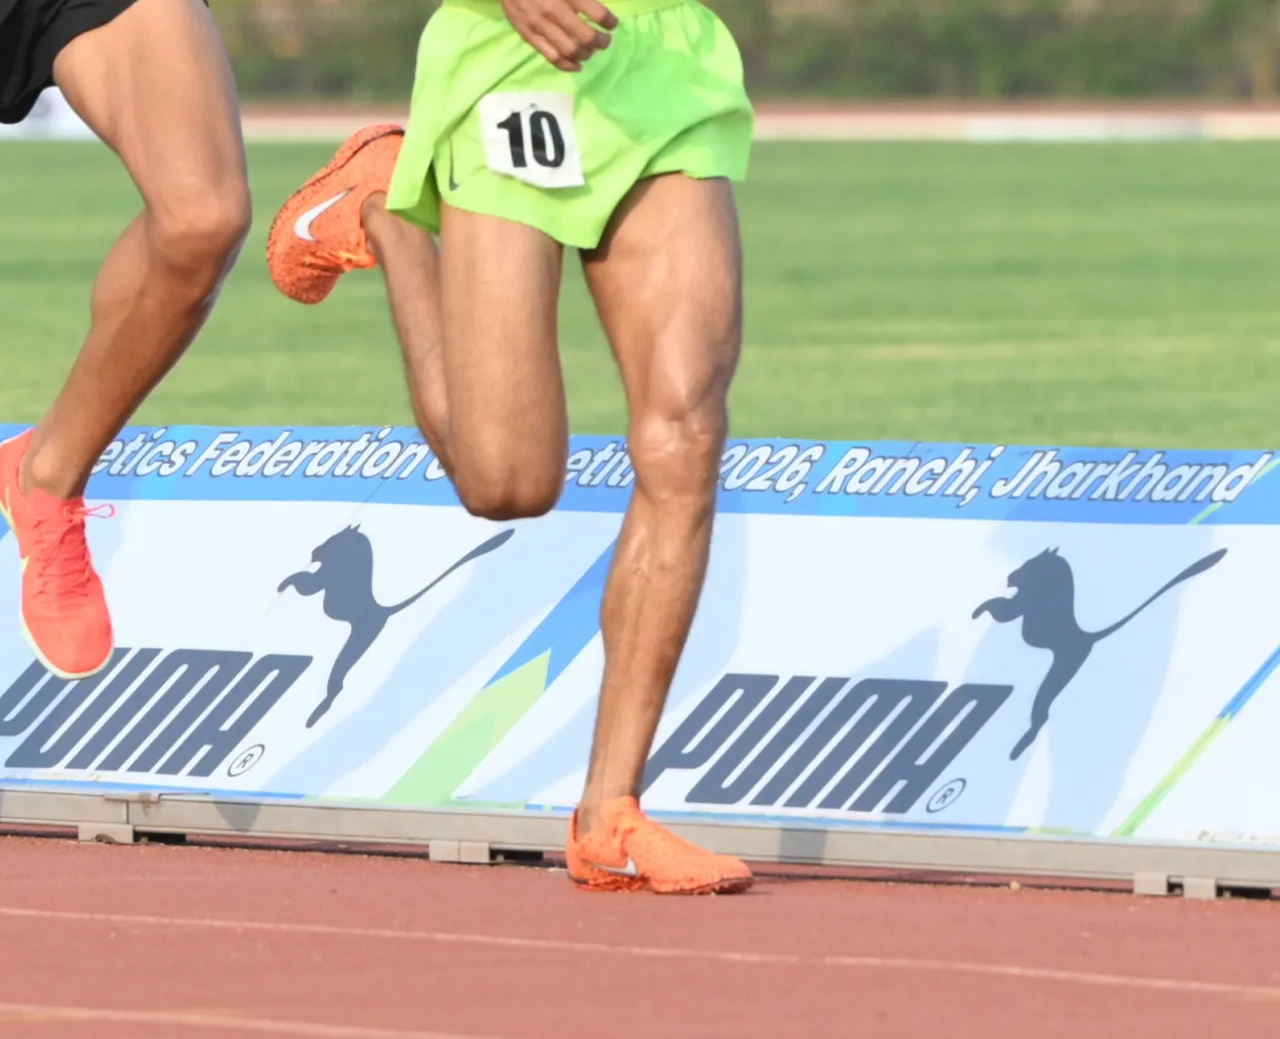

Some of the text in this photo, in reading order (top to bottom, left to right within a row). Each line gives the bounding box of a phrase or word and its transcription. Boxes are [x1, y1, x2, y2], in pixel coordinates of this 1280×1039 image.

[496, 110, 566, 169] 10
[183, 425, 431, 481] Federation
[813, 444, 1007, 508] Ranchi,
[989, 448, 1274, 504] Jharkhand
[640, 672, 1014, 814] PUMA
